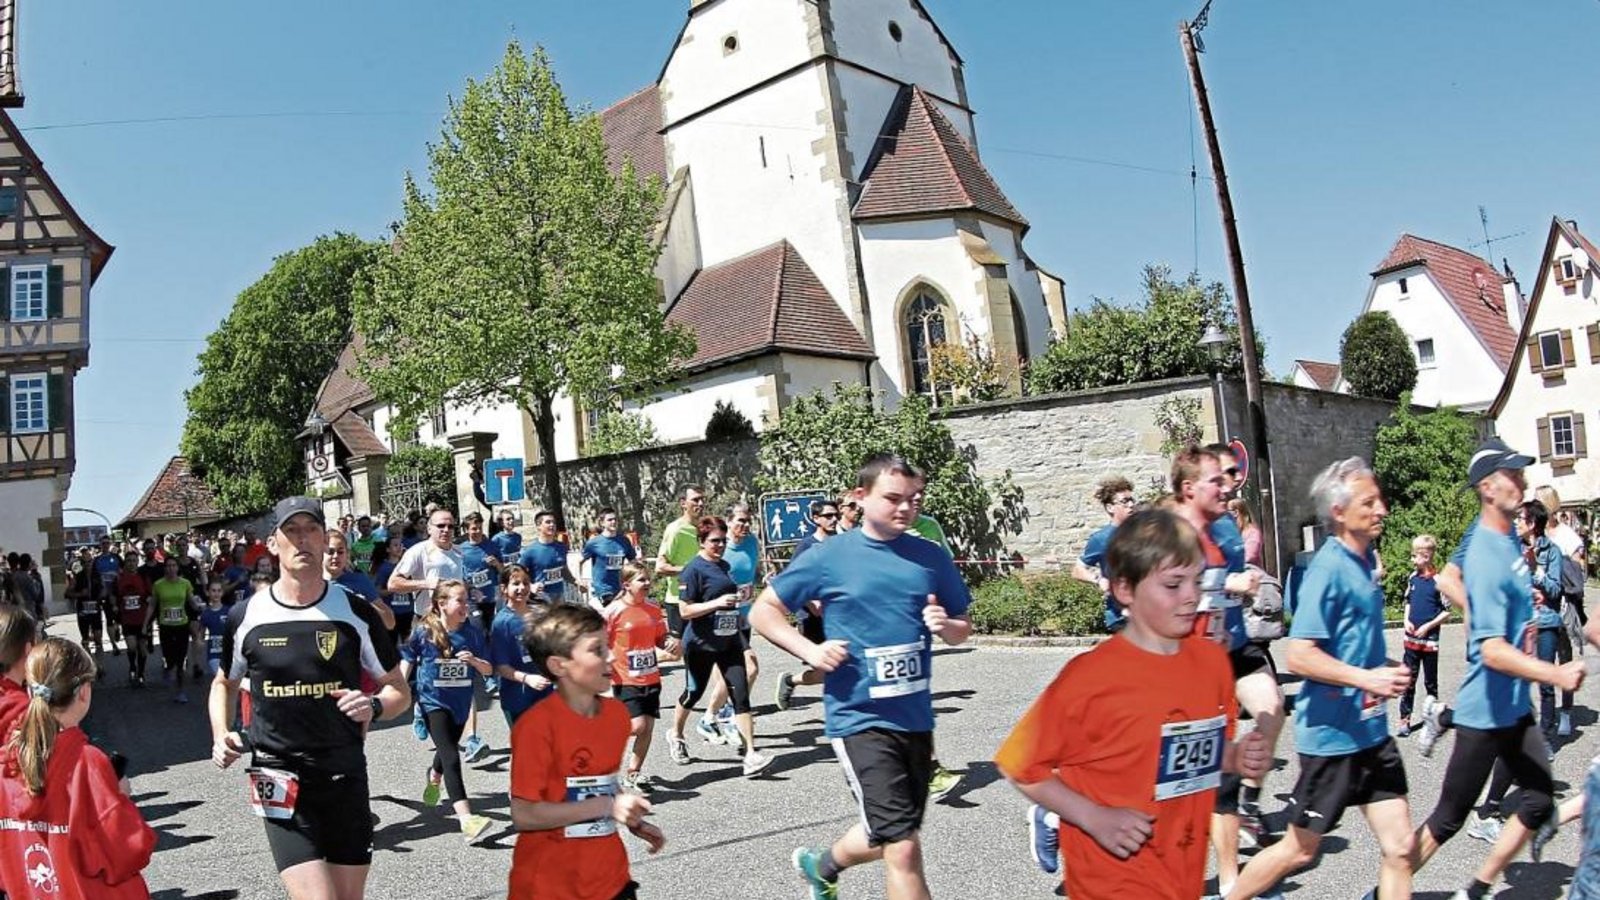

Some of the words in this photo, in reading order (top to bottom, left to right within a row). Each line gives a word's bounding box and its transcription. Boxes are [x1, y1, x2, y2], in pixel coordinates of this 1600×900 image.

[442, 666, 465, 677] 224
[883, 657, 917, 679] 220
[262, 680, 342, 699] Ensinger
[1173, 739, 1213, 771] 249
